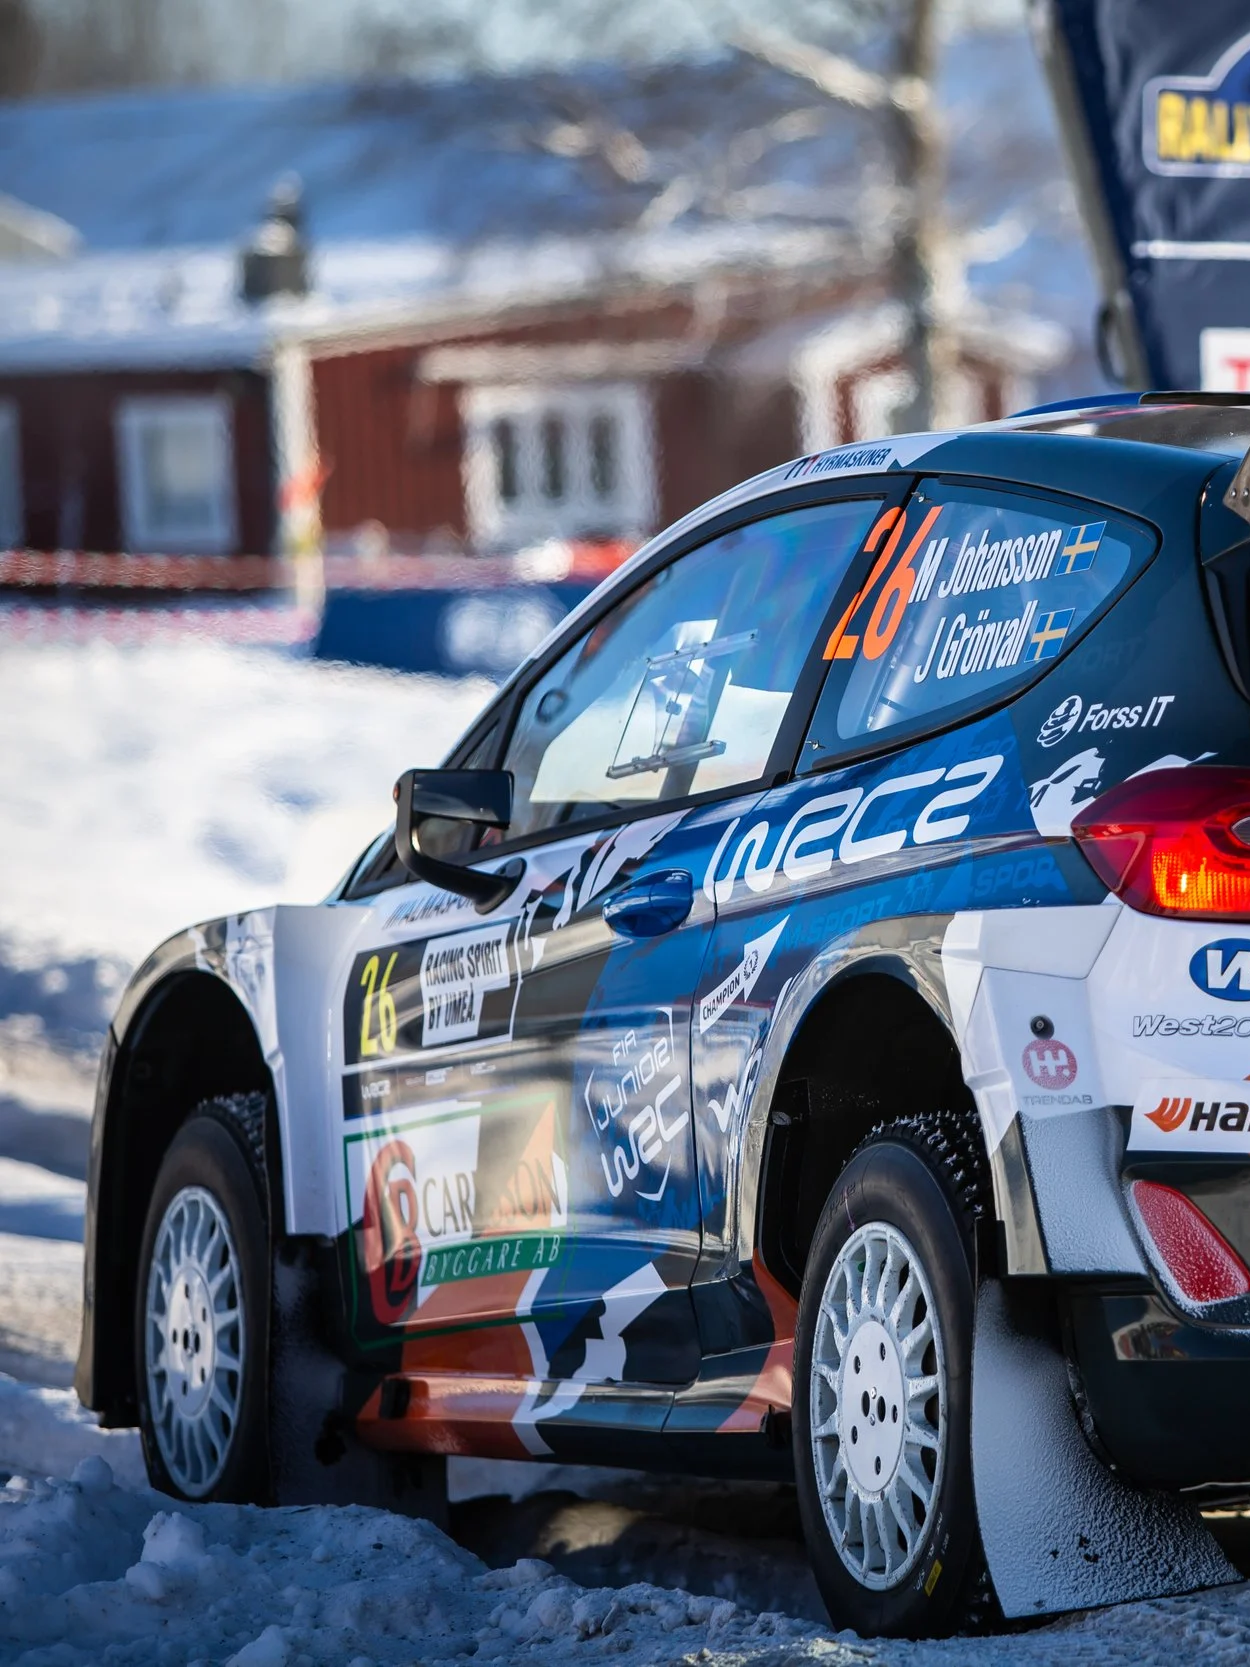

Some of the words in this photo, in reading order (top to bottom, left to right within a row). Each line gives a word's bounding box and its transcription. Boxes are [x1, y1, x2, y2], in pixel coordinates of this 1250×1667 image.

[811, 448, 893, 474] HYRMASKINER
[822, 505, 943, 660] 26
[909, 537, 947, 603] M
[937, 528, 1064, 599] Johansson
[914, 616, 946, 683] J
[937, 600, 1038, 680] Grönvall
[1078, 703, 1142, 733] Forss
[1141, 695, 1175, 727] IT
[425, 947, 465, 987] RACING
[467, 939, 503, 978] SPIRIT
[360, 952, 398, 1057] 26
[428, 996, 442, 1030] BY
[703, 973, 740, 1020] CHAMPION
[612, 1029, 637, 1066] FIA
[597, 1037, 671, 1131] JUNIOR
[1022, 1094, 1094, 1106] TRENDAB
[426, 1240, 523, 1282] BYGGARE
[532, 1234, 561, 1264] AB
